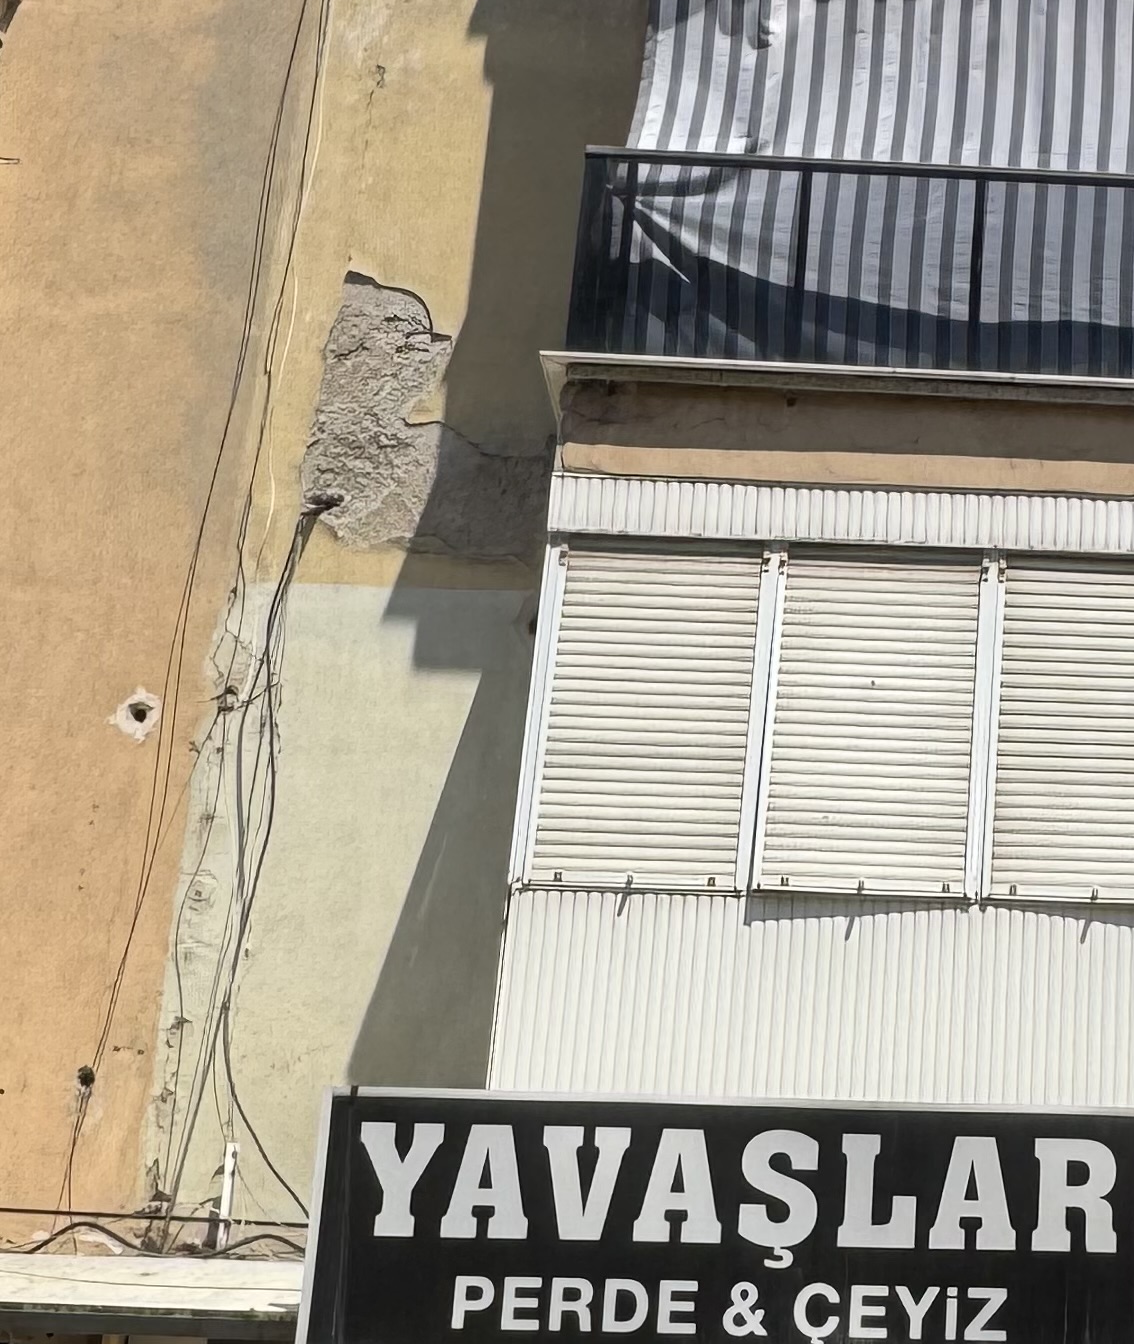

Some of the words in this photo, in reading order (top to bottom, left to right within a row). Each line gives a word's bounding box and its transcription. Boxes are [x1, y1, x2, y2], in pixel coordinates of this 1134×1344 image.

[360, 1121, 1118, 1269] YAVAŞLAR
[451, 1275, 699, 1335] PERDE
[722, 1281, 768, 1337] &
